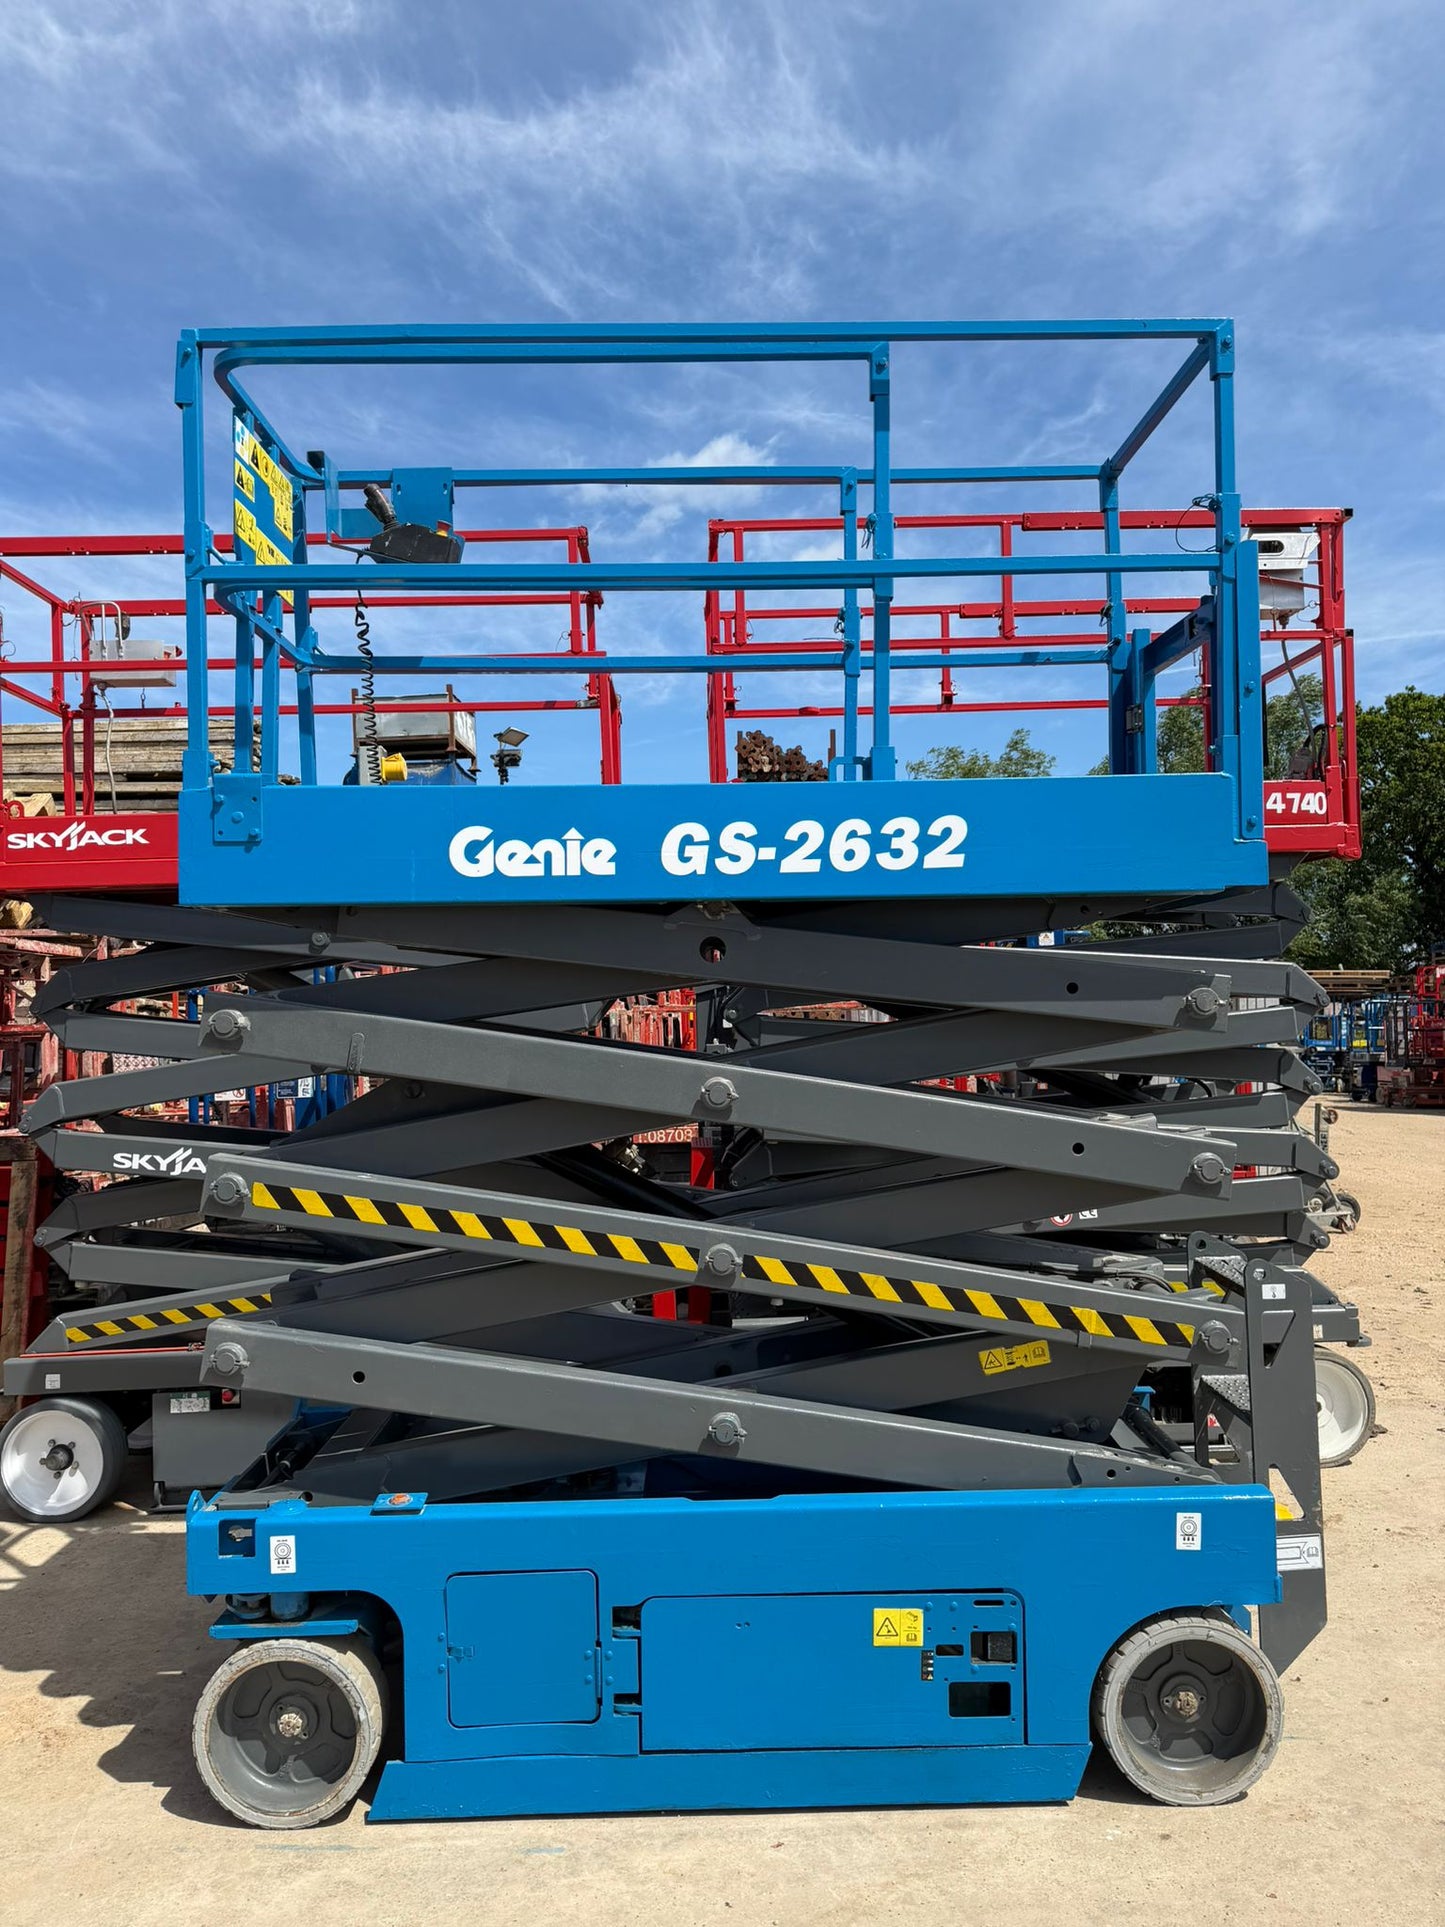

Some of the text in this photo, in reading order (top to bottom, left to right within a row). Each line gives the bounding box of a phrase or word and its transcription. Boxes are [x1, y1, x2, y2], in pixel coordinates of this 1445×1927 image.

[1266, 791, 1327, 815] 4740
[7, 821, 150, 851] SKYJACK
[449, 814, 968, 878] Genie GS-2632
